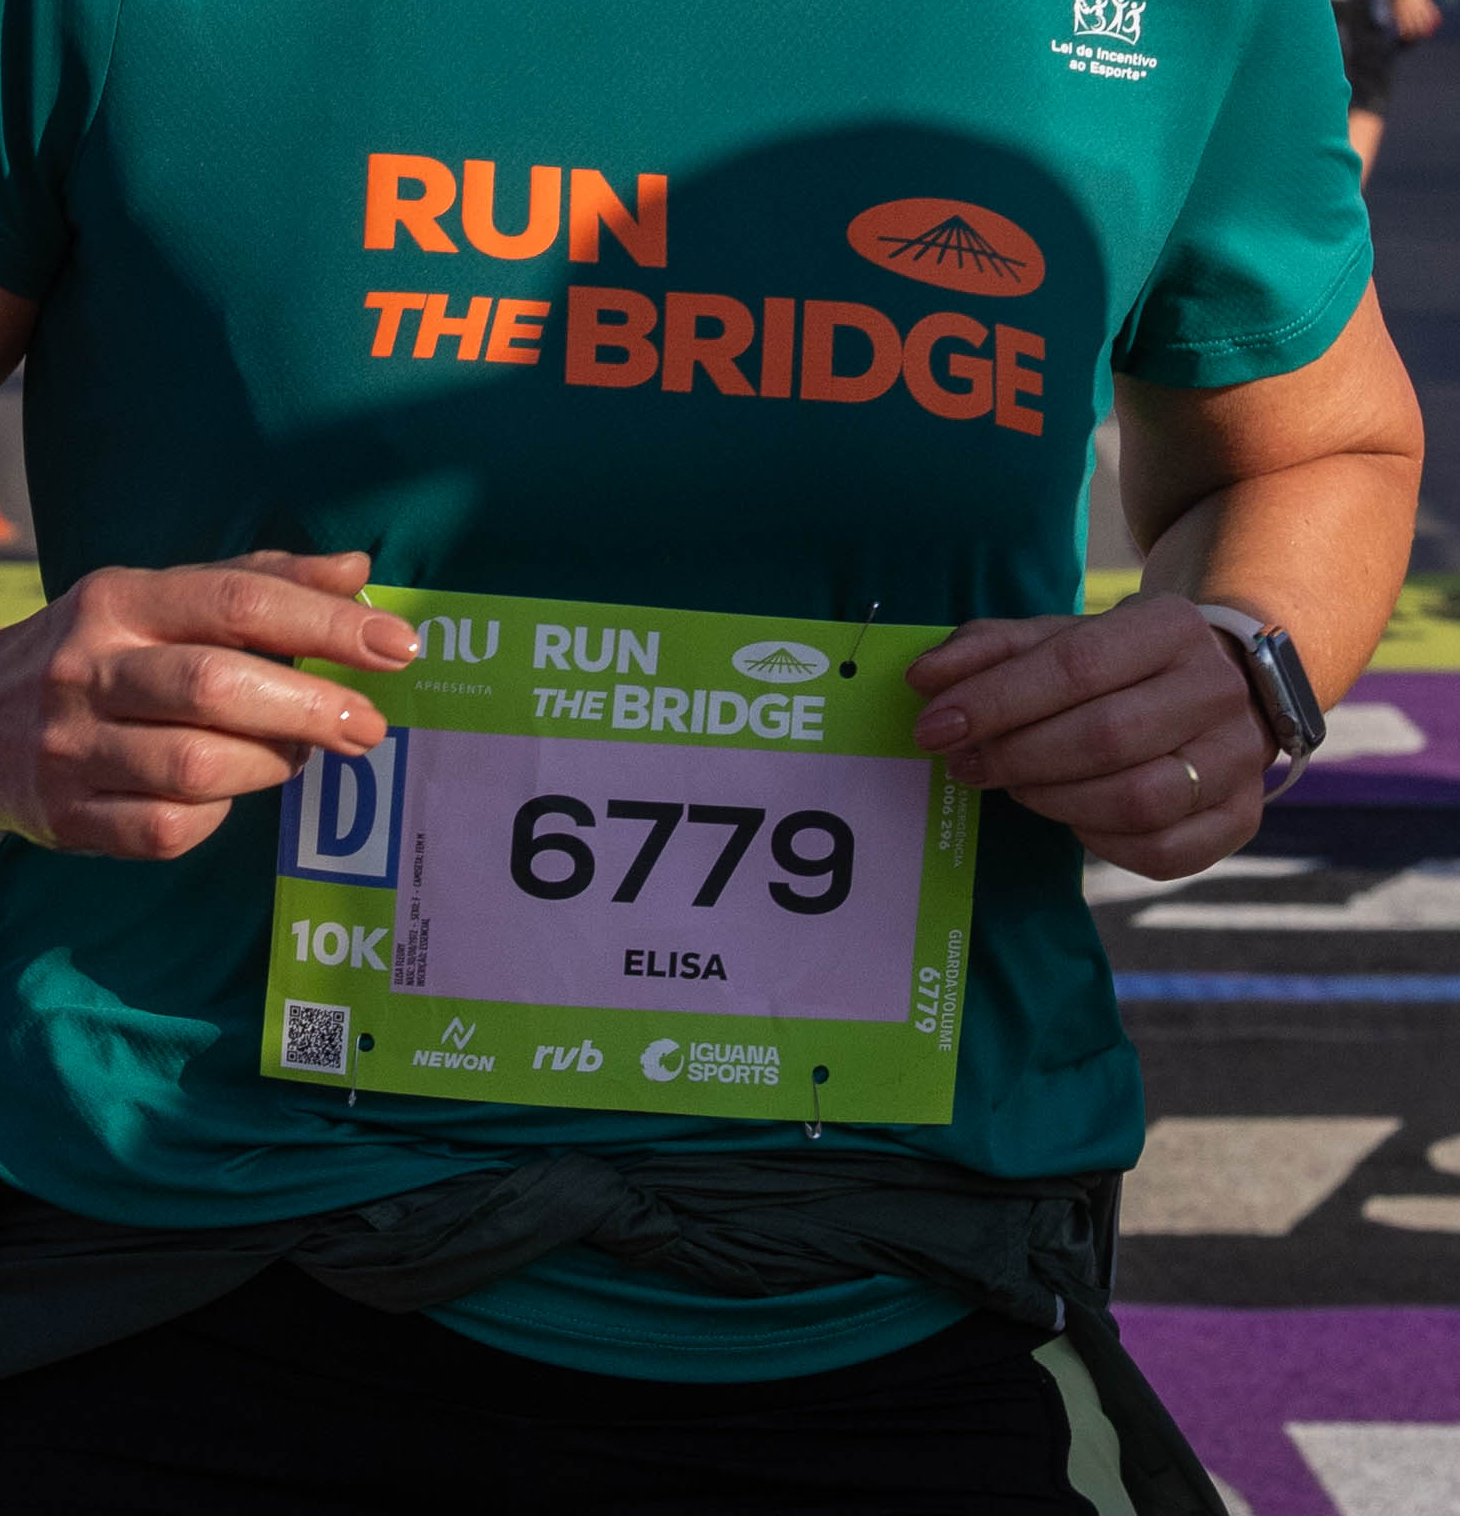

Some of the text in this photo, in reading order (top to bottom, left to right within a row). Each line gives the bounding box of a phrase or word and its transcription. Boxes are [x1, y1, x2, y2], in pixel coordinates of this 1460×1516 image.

[1051, 39, 1158, 68] Lei de Incentivo
[1069, 59, 1086, 71] ao
[363, 153, 668, 269] RUN
[364, 286, 1046, 437] THE BRIDGE
[533, 623, 660, 675] RUN
[415, 680, 493, 695] APRESENTA
[532, 684, 826, 741] THE BRIDGE
[316, 747, 378, 857] D
[942, 785, 956, 815] 006
[940, 820, 953, 850] 296
[510, 794, 855, 916] 6779
[290, 919, 390, 972] 10K
[623, 949, 728, 982] ELISA
[915, 967, 941, 1034] 6779
[939, 929, 963, 1051] GUARDA-VOLUME
[412, 1049, 496, 1072] NEWON
[532, 1040, 603, 1072] rvb
[688, 1042, 780, 1066] IGUANA
[687, 1062, 779, 1085] SPORTS
